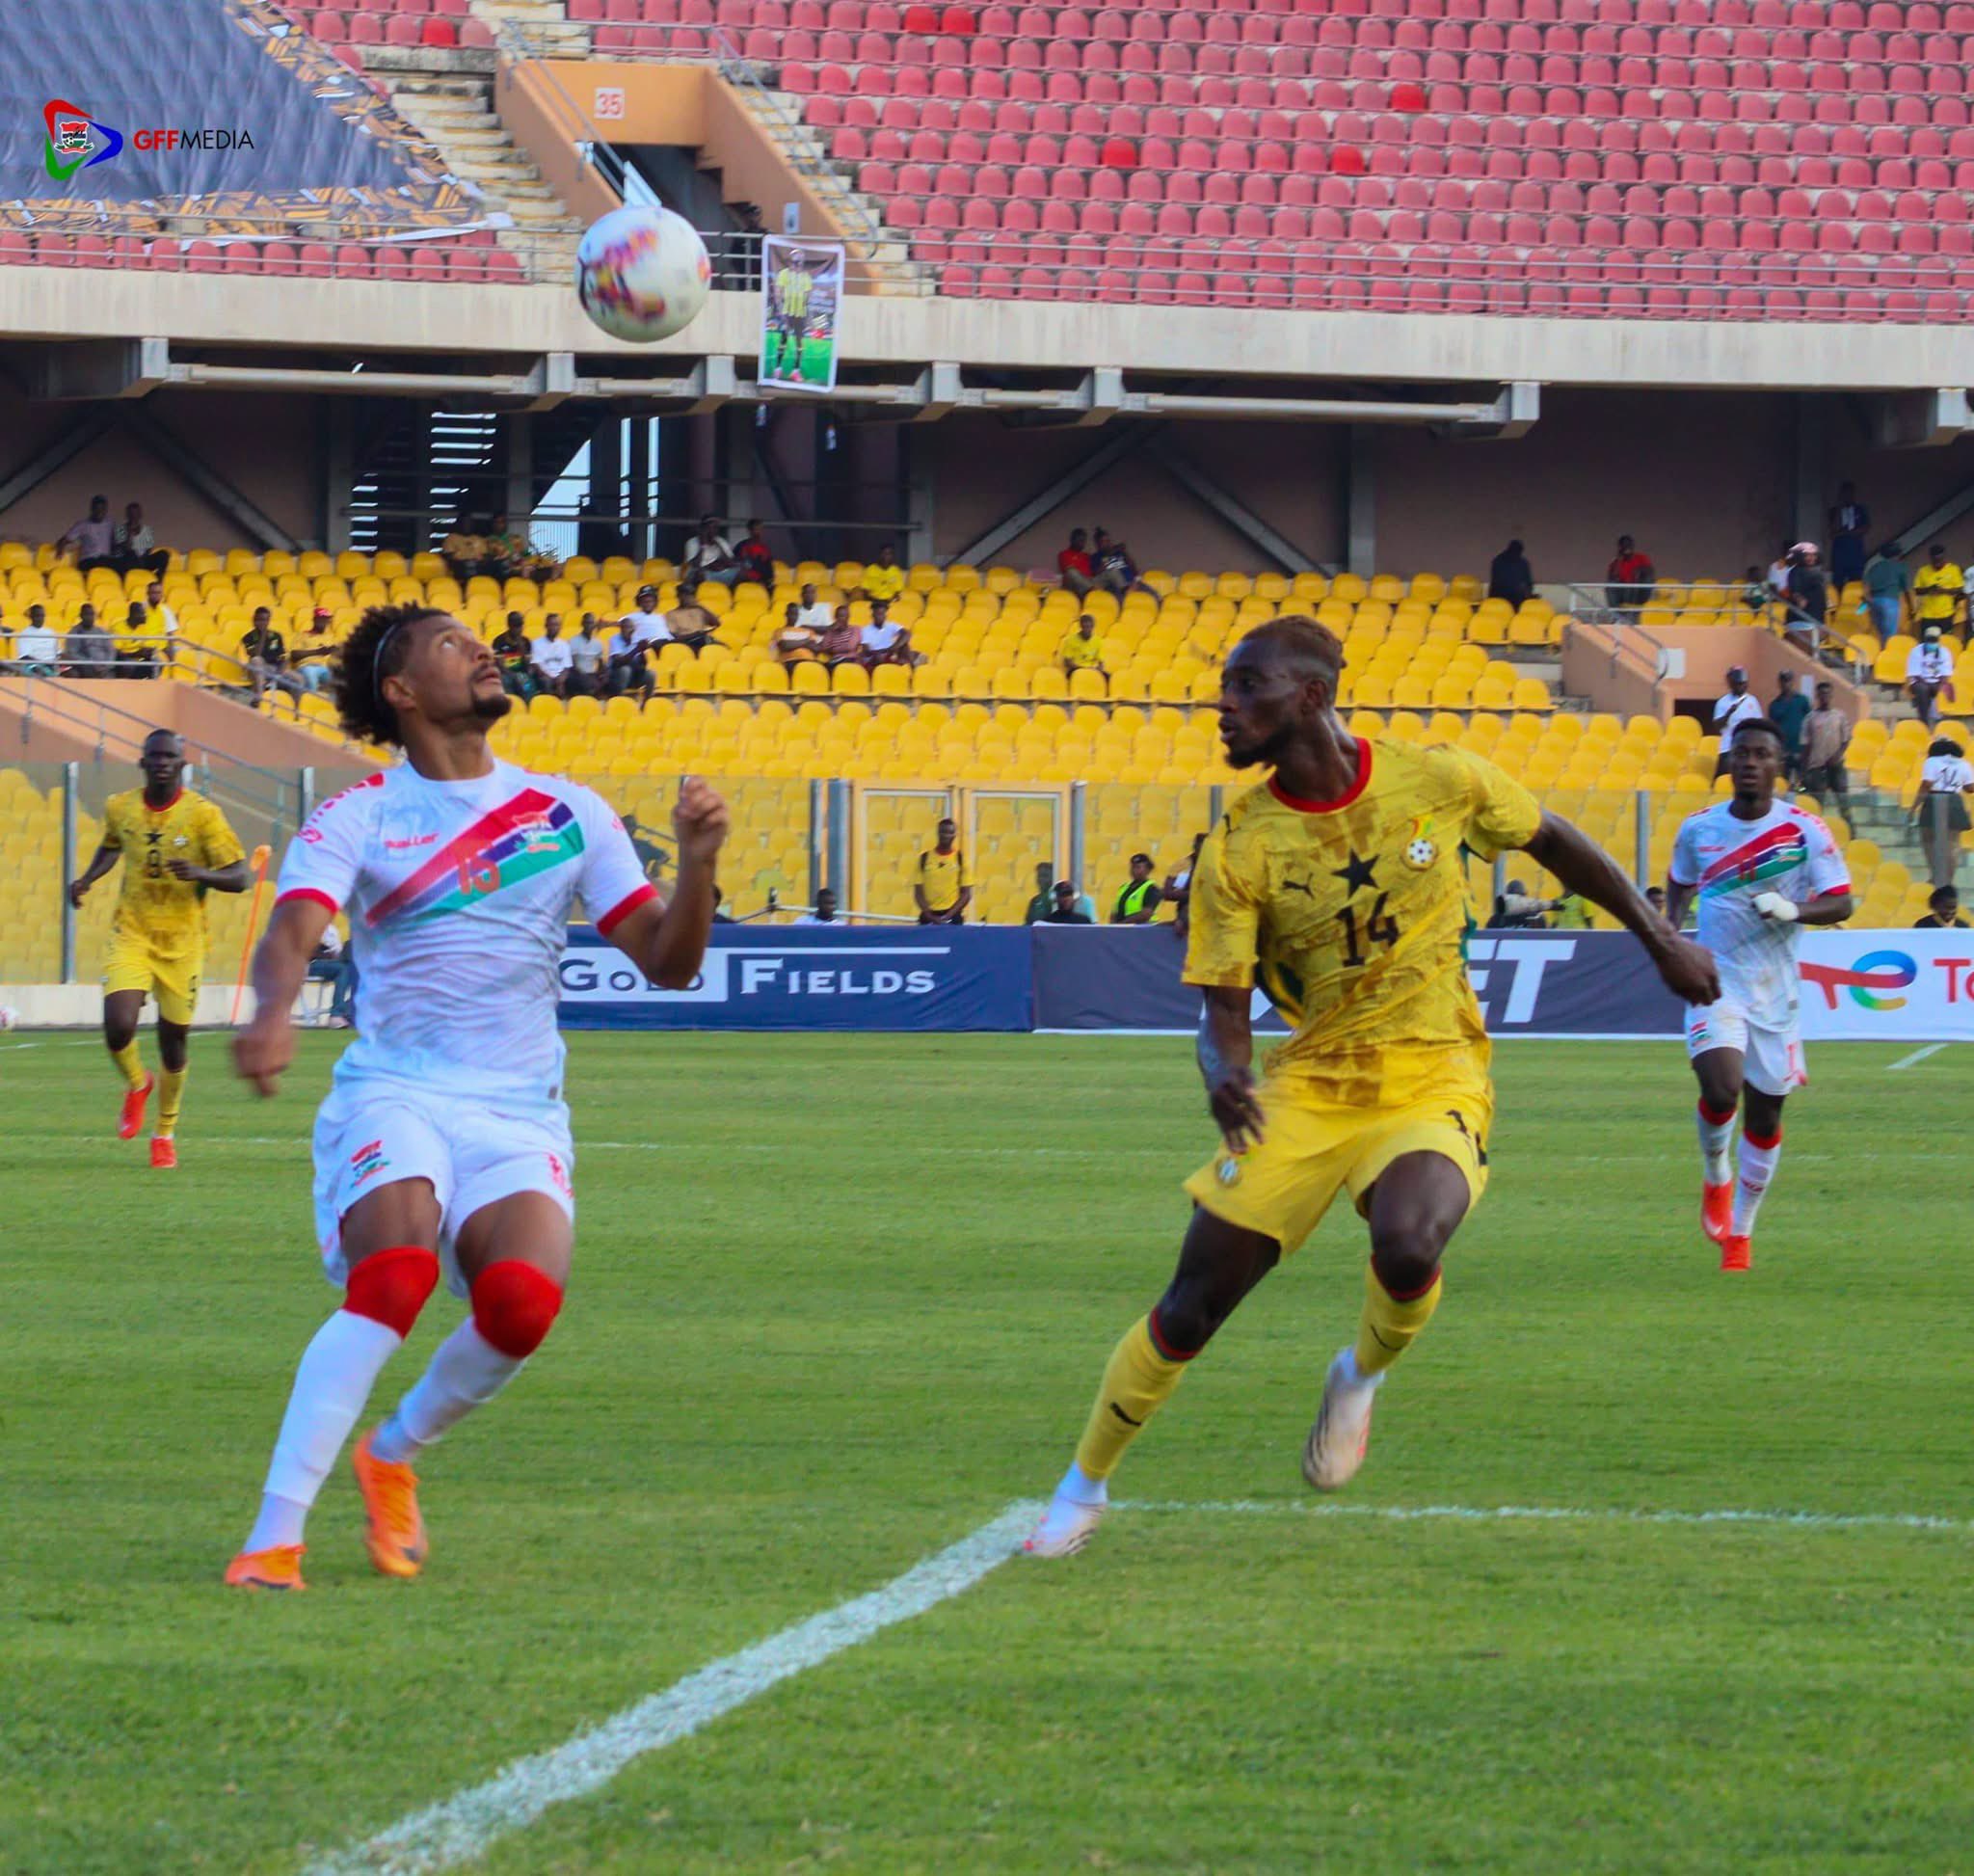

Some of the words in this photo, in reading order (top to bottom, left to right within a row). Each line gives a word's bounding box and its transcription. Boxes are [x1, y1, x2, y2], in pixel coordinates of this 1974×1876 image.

[599, 94, 621, 115] 35
[1334, 891, 1400, 968] 14
[740, 958, 935, 994] FIELDS
